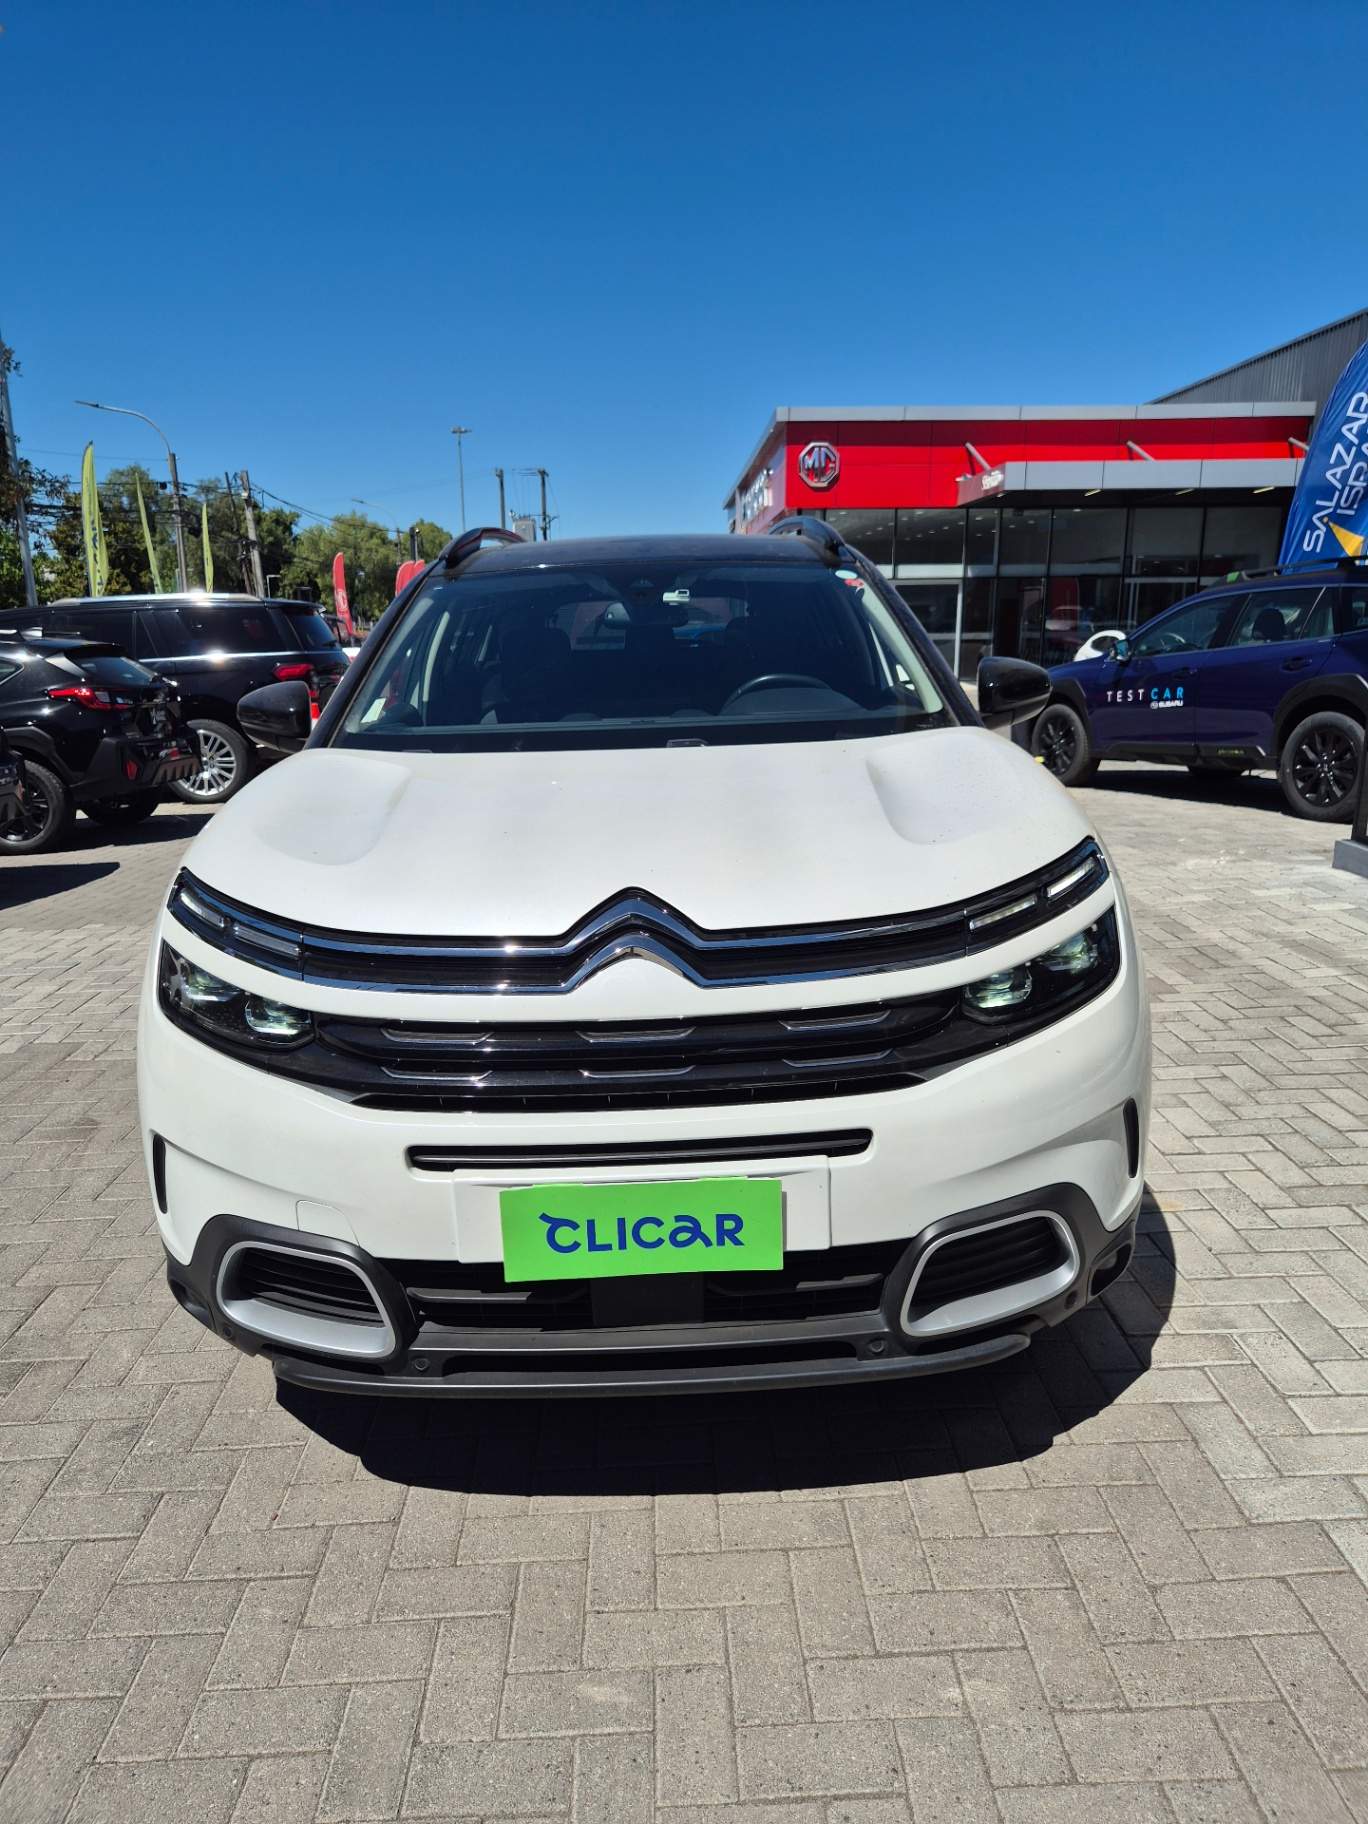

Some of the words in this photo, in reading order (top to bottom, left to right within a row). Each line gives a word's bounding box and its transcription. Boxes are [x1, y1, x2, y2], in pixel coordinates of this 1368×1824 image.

[802, 445, 838, 485] MG
[1106, 688, 1145, 702] TEST
[1150, 687, 1184, 700] CAR
